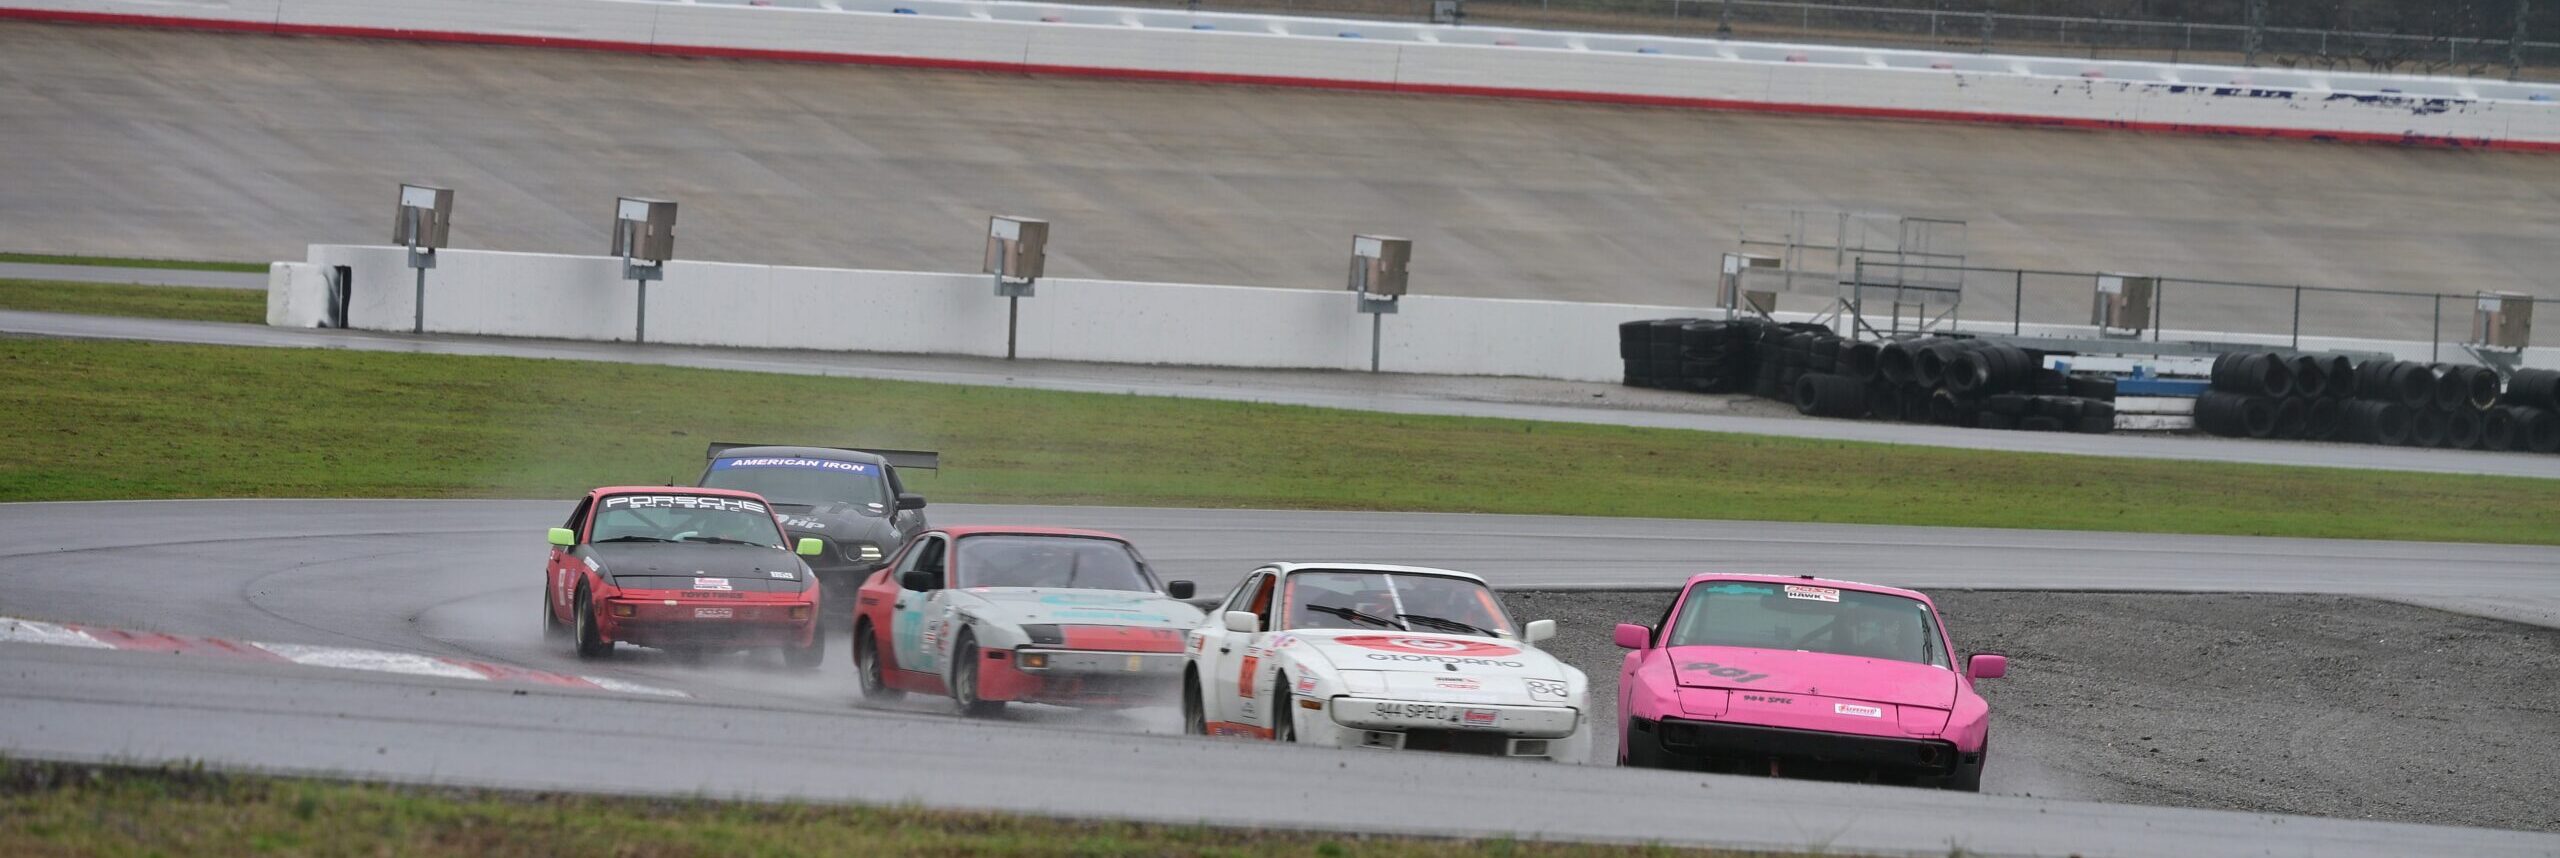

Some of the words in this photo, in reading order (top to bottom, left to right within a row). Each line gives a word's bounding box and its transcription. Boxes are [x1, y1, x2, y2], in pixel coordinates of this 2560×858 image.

[731, 458, 820, 468] AMERICAN
[823, 461, 865, 472] IRON
[606, 495, 765, 514] PORSCHE
[680, 591, 710, 599] TOYO
[1528, 681, 1568, 698] 88
[1404, 703, 1448, 720] SPEC
